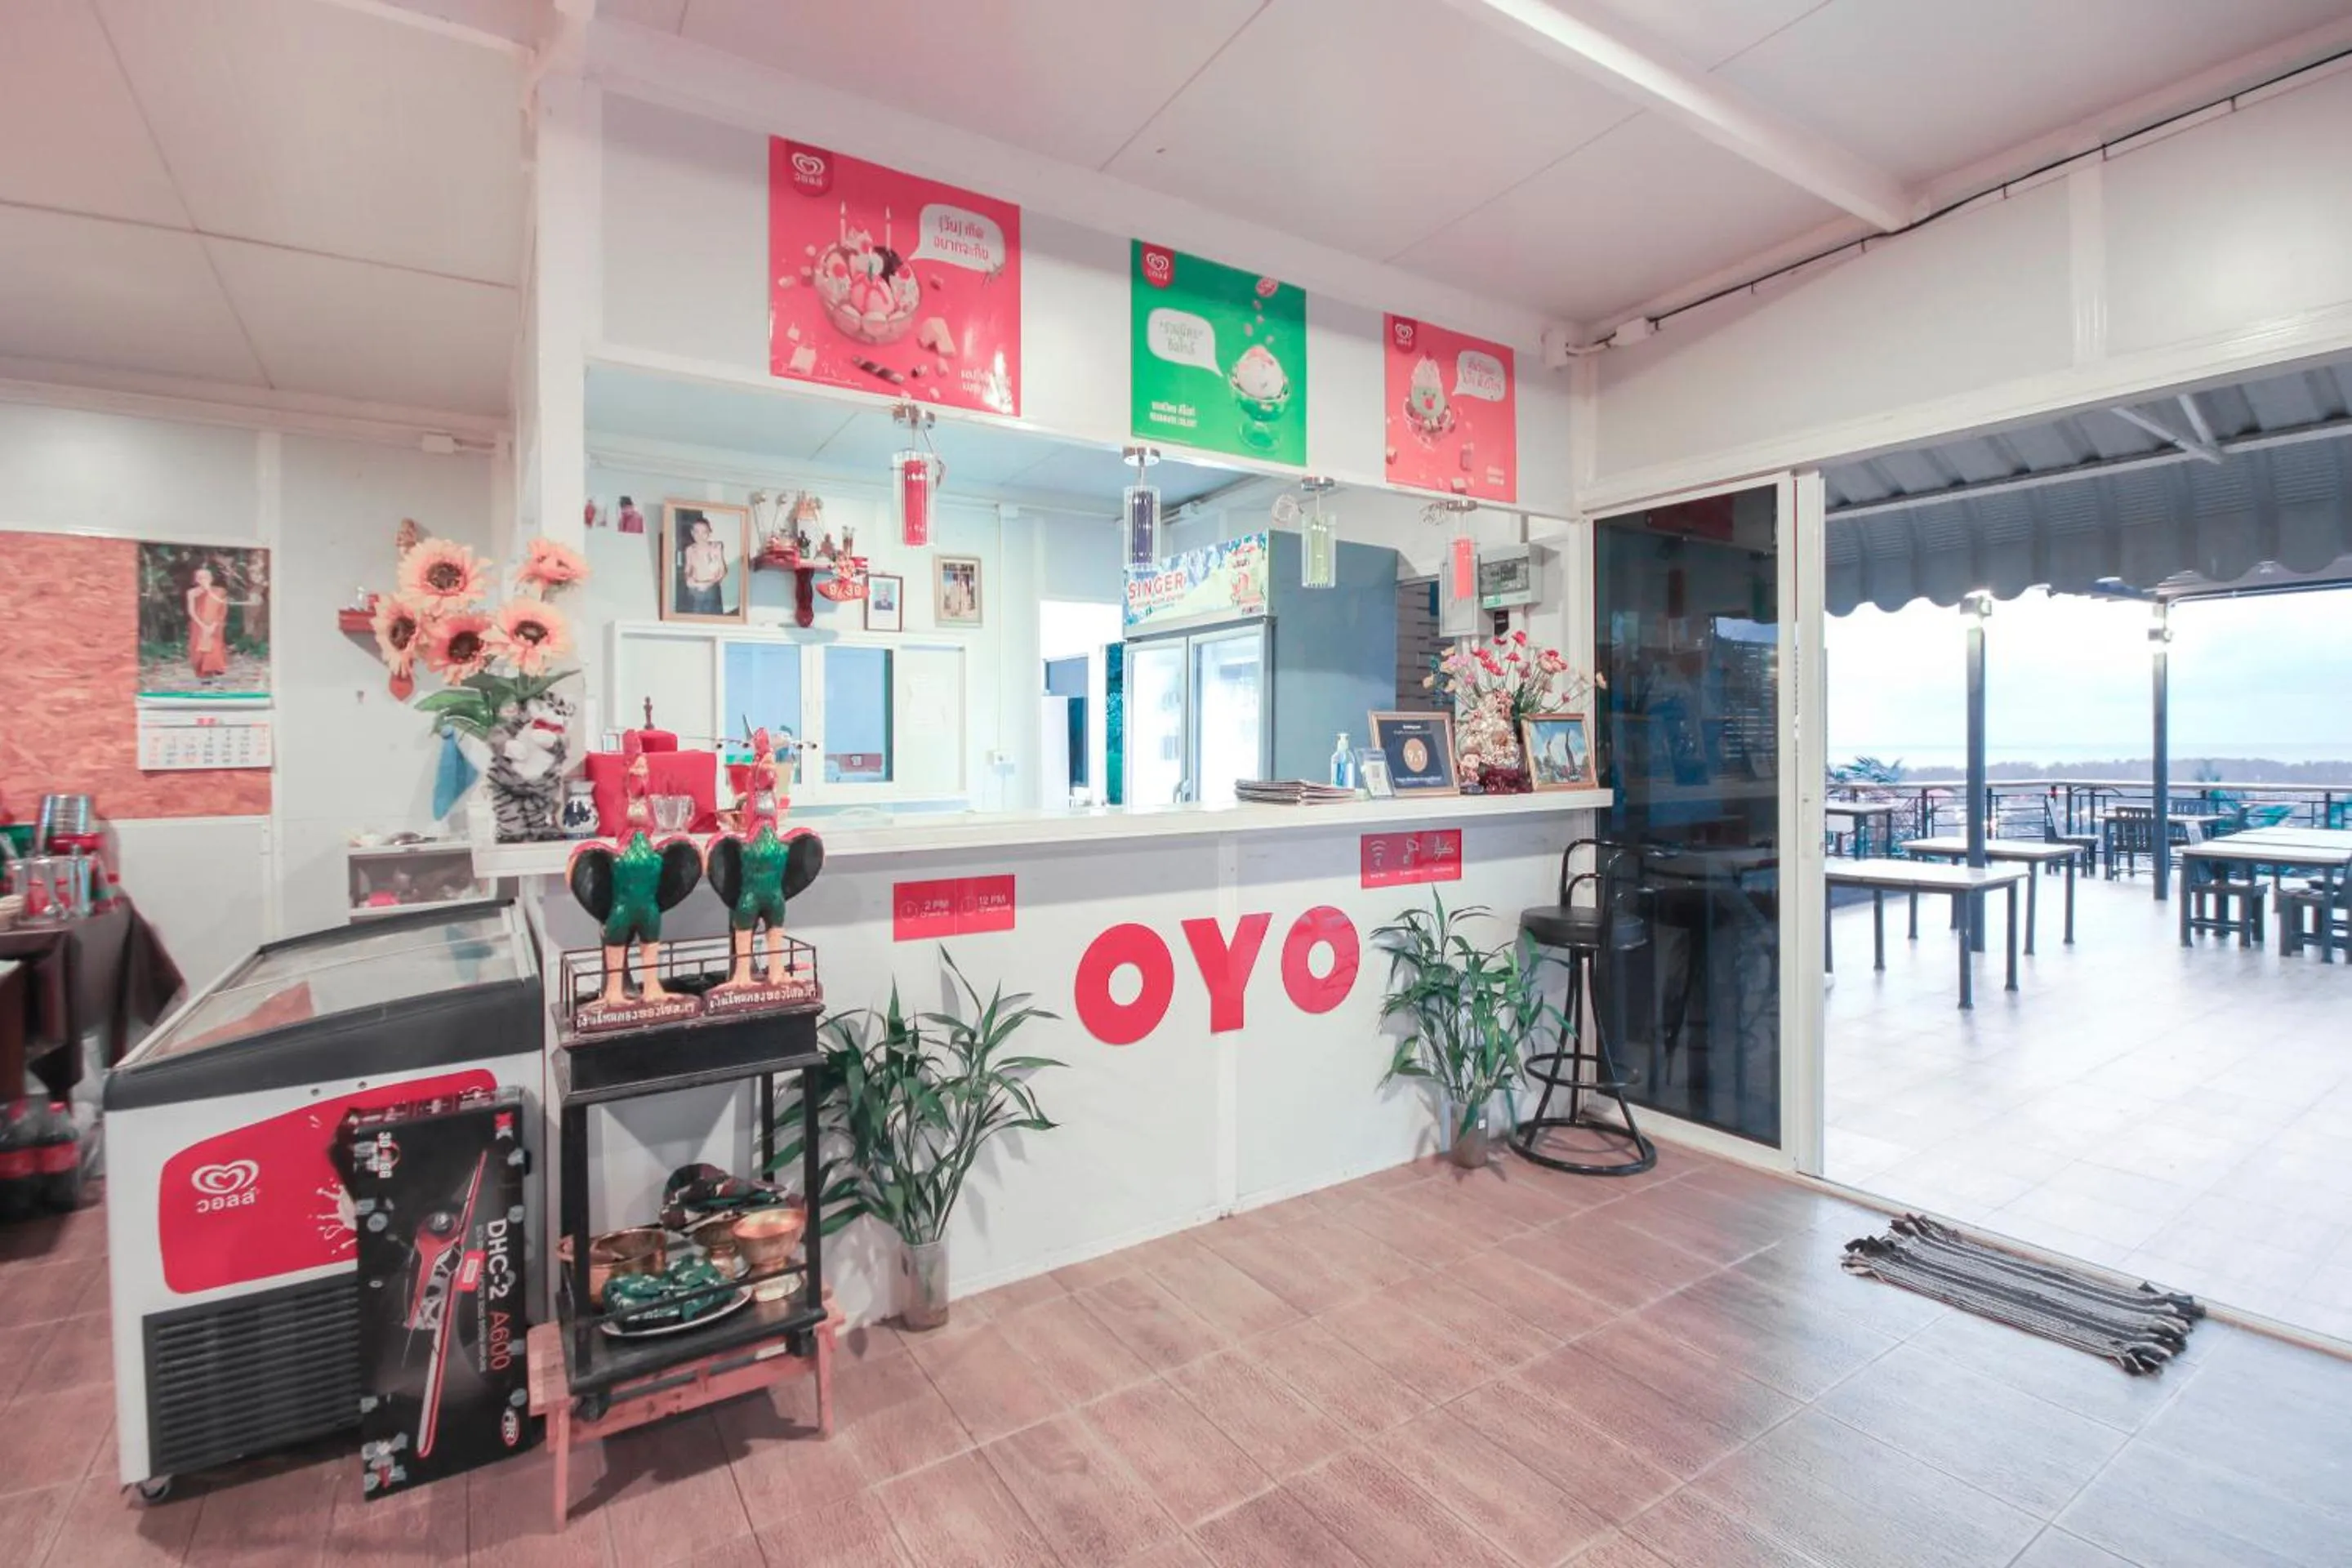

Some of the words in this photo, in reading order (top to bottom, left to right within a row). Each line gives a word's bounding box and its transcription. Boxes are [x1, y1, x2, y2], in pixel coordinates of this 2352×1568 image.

[1128, 571, 1184, 600] SINGER
[1074, 904, 1360, 1045] OYO
[196, 1186, 256, 1214] วอลล์
[487, 1218, 509, 1301] DHC-2
[488, 1311, 512, 1370] A600
